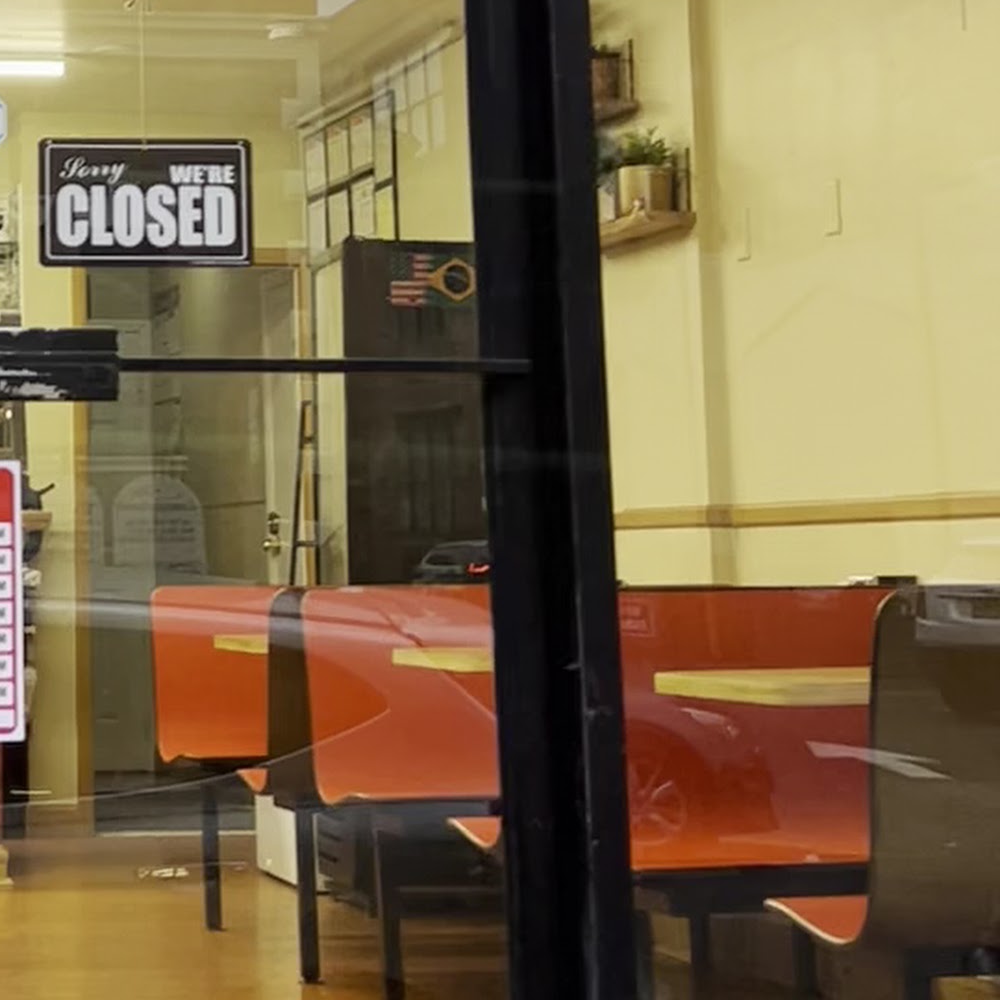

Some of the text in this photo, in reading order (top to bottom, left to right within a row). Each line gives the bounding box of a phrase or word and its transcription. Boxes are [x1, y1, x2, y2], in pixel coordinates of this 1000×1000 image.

[59, 156, 236, 185] Sorry WE'RE
[56, 184, 237, 248] CLOSED
